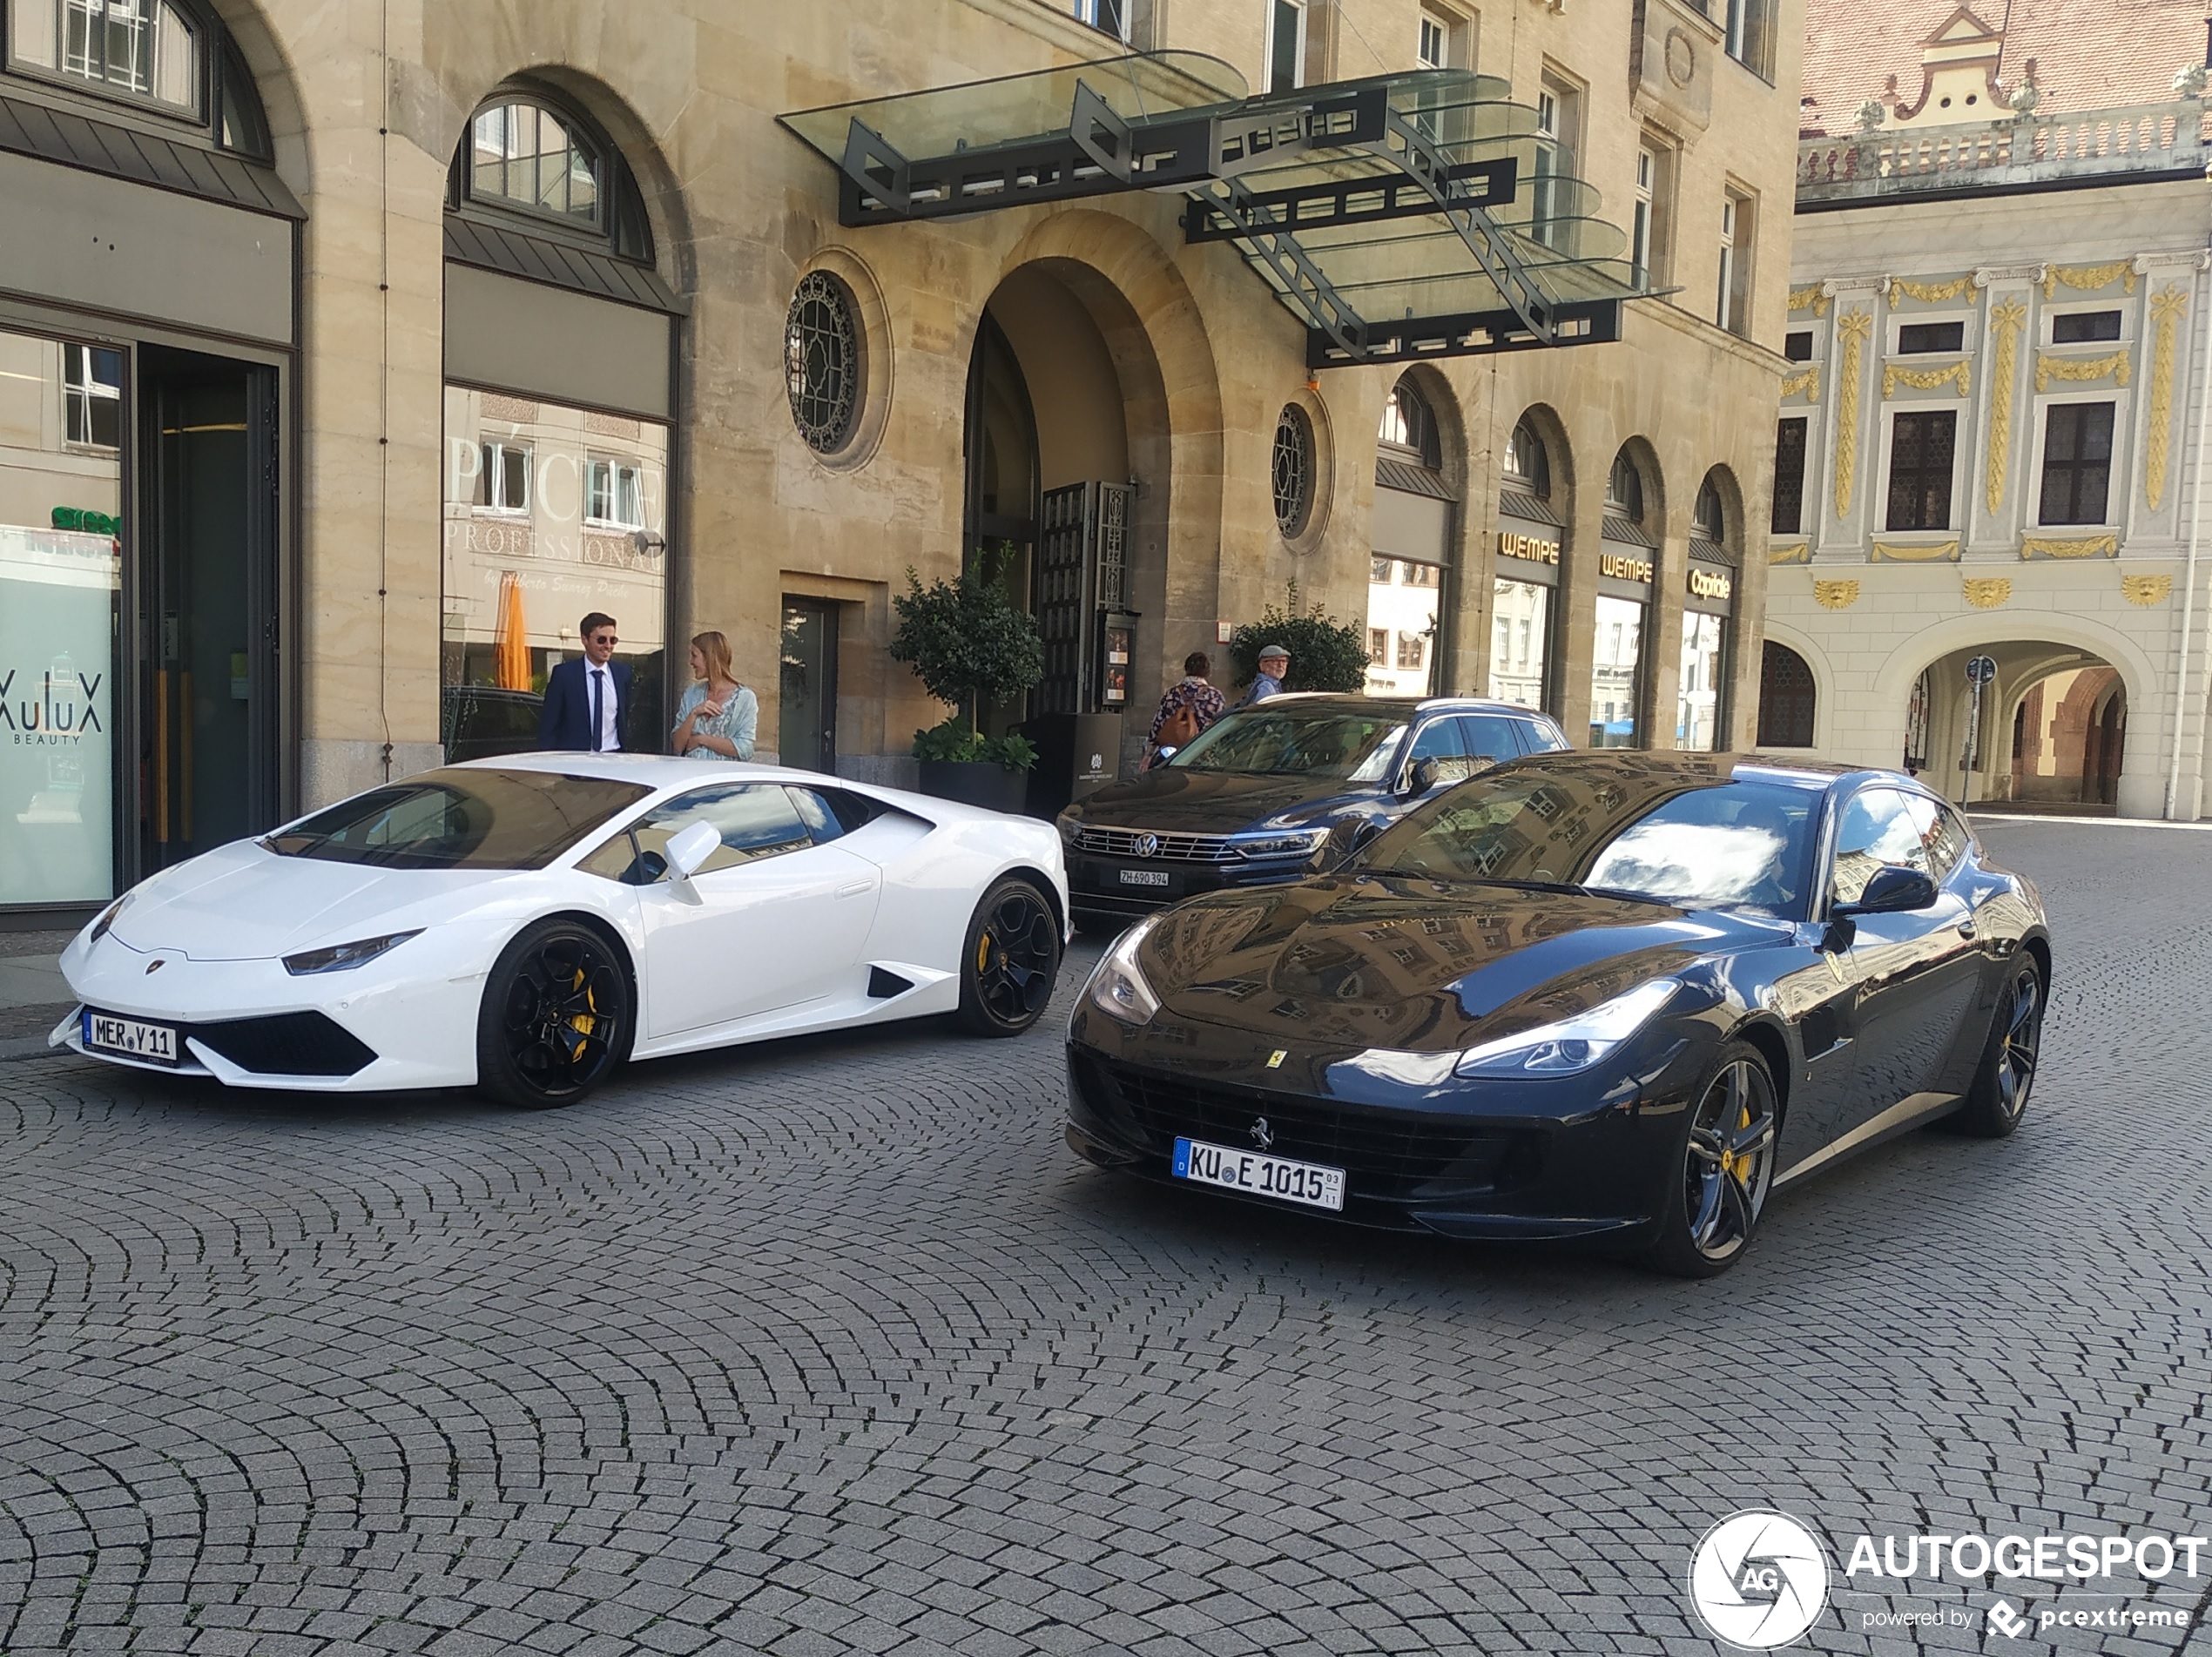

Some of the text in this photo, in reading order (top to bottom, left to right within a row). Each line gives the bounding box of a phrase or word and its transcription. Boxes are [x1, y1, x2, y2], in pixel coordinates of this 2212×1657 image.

[1501, 532, 1559, 565] WEMPE
[483, 569, 498, 589] by
[502, 571, 547, 590] Alberto
[1602, 554, 1653, 583] WEMPE
[1691, 569, 1730, 601] Capitale
[14, 734, 80, 745] BEAUTY
[96, 1018, 125, 1047] MER
[149, 1029, 170, 1055] 11
[1190, 1147, 1222, 1181] KU
[1259, 1162, 1324, 1201] 1015
